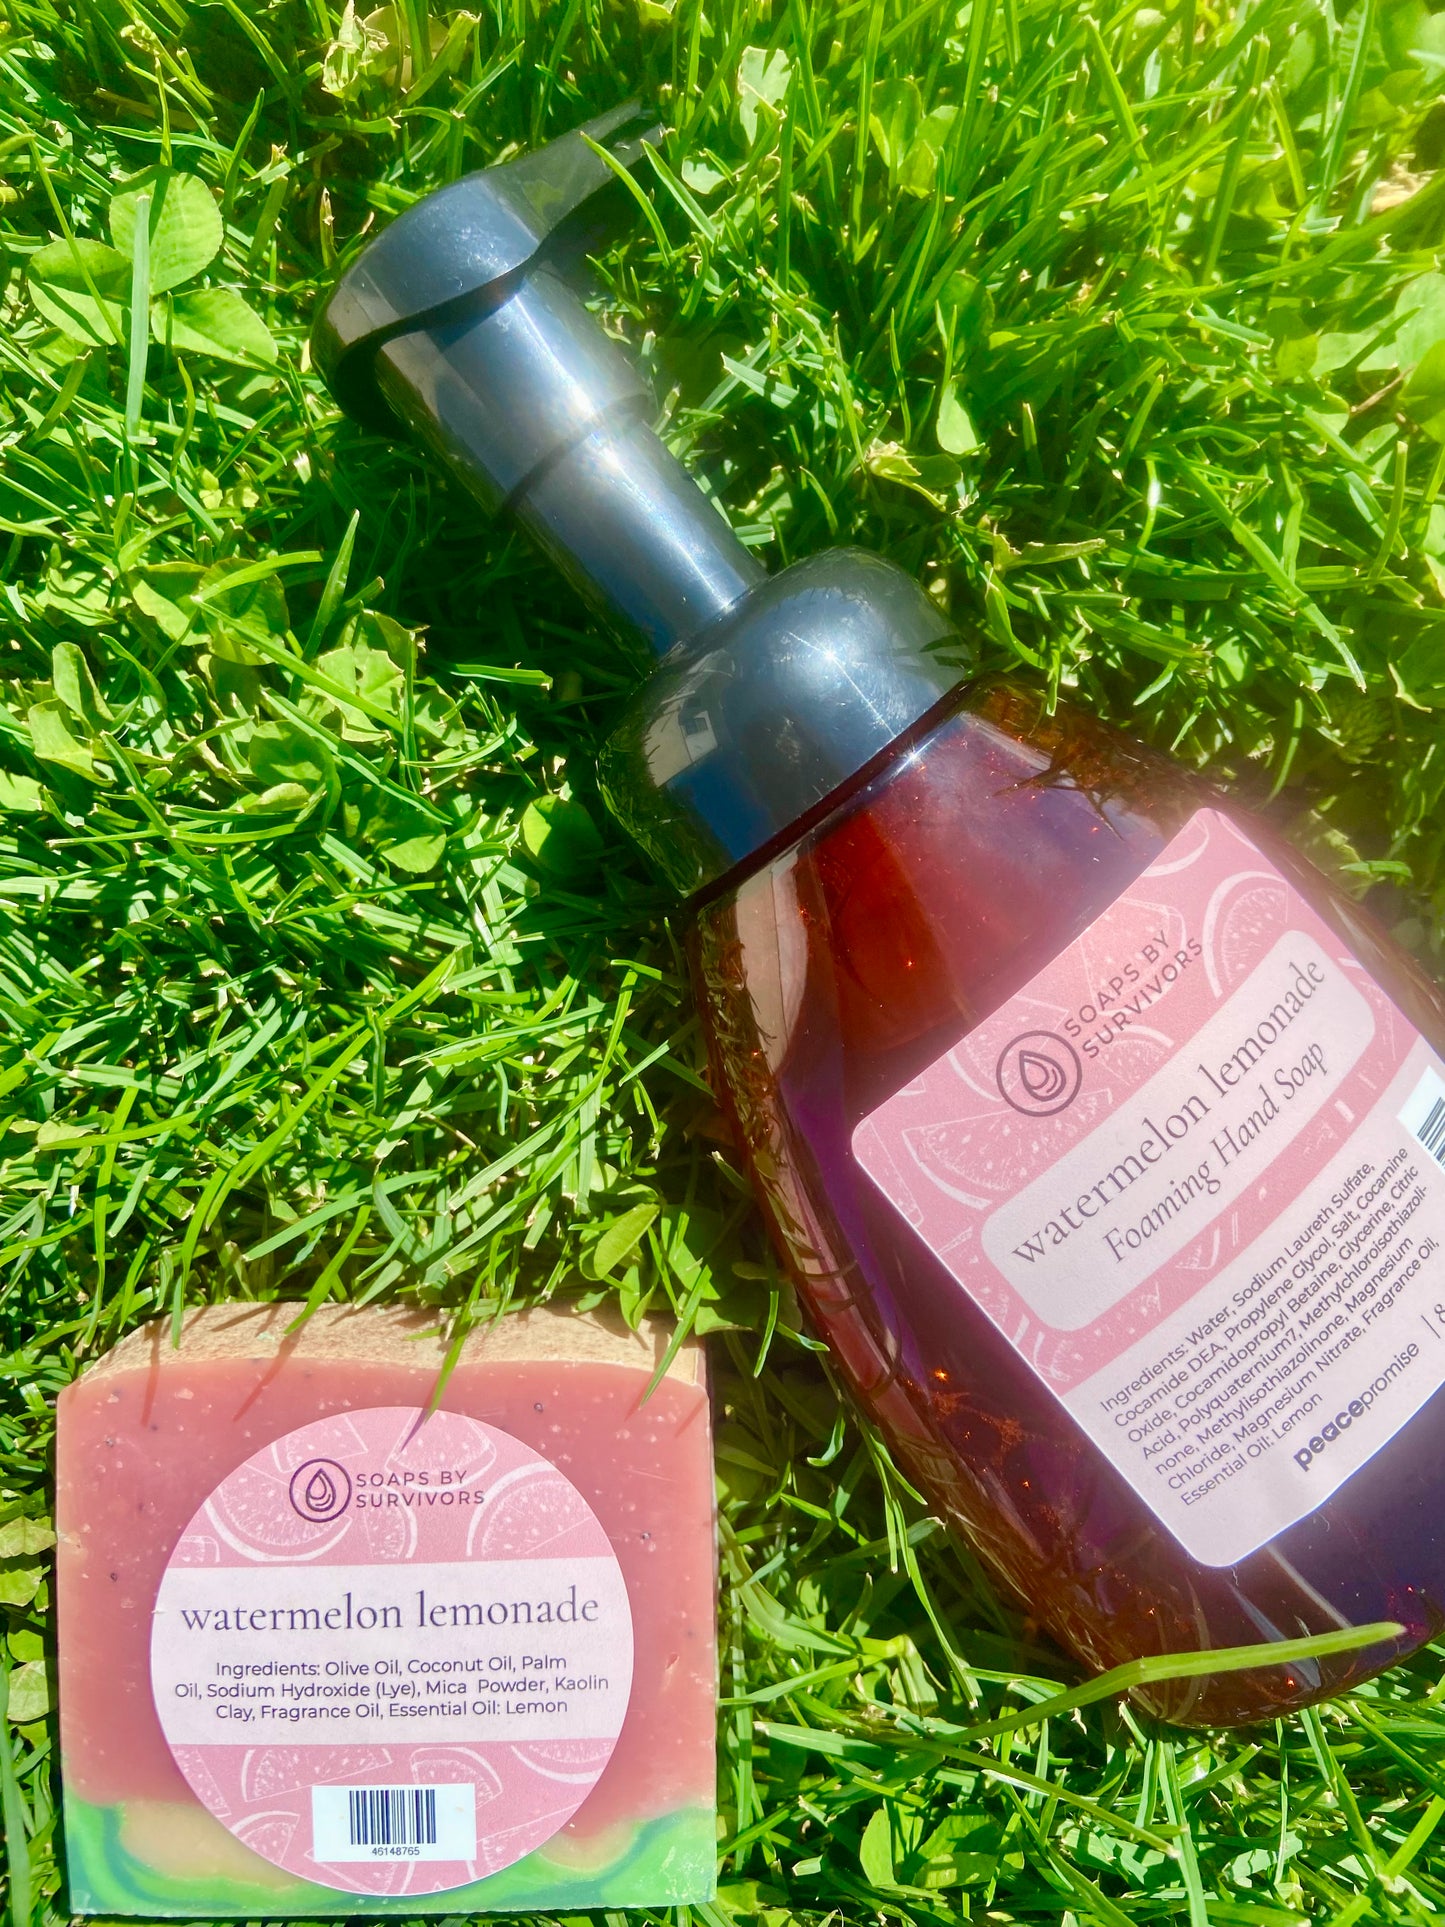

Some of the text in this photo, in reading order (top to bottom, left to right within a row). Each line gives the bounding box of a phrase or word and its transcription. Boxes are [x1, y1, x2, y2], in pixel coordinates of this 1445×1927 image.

[1064, 930, 1170, 1038] SOAPS BY
[1083, 937, 1202, 1058] SURVIVORS
[1012, 961, 1326, 1264] watermelon lemonade
[1102, 1042, 1328, 1263] Foaming Hand Soap
[1100, 1164, 1375, 1412] Ingredients: Water, Sodium Laureth Sulfate,
[1115, 1148, 1408, 1427] Cocamide DEA, Propylene Glycol, Salt, Cocamine
[1128, 1165, 1418, 1442] Oxide, Cocamidopropyl Betaine, Glycerine, Citric
[1142, 1186, 1427, 1460] Acid, Polyquaternium7, Methylchloroisothiazoli-
[1155, 1238, 1414, 1475] none, Methylisothiazolinone, Magnesium
[1168, 1237, 1440, 1490] Chloride, Magnesium Nitrate, Fragrance Oil,
[356, 1470, 467, 1488] SOAPS BY
[356, 1490, 485, 1509] SURVIVORS
[1180, 1393, 1323, 1506] Essential Oil: Lemon
[181, 1586, 600, 1631] watermelon lemonade
[216, 1655, 566, 1679] Ingredients: Olive Oil, Coconut Oil, Palm
[175, 1675, 608, 1701] Oil, Sodium Hydroxide (Lye), Mica Powder, Kaolin
[216, 1699, 568, 1722] Clay, Fragrance Oil, Essential Oil: Lemon
[372, 1847, 420, 1856] 46148765
